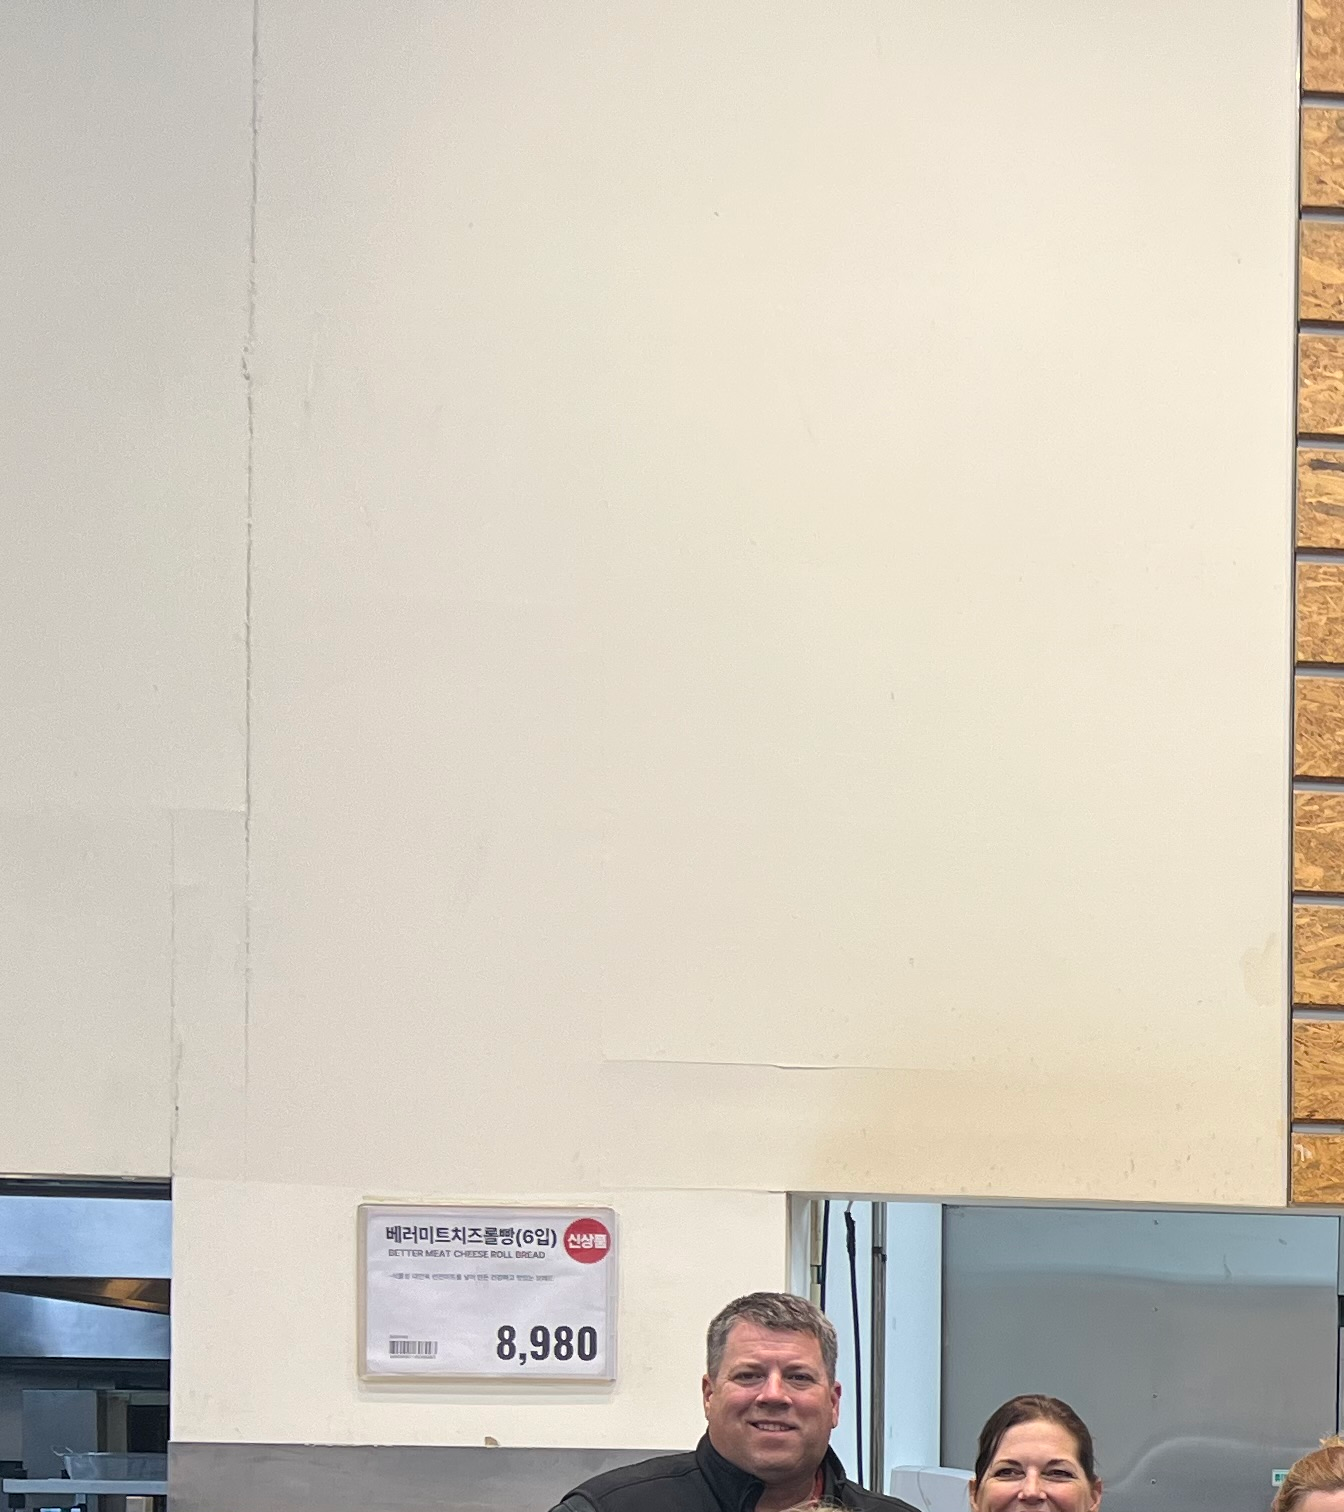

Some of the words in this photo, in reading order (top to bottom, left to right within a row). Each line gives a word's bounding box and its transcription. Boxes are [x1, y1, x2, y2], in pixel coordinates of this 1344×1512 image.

[386, 1226, 557, 1248] 베러미트치즈롤빵(6입)
[567, 1233, 607, 1249] 신상품
[388, 1249, 423, 1257] BETTER
[426, 1249, 451, 1257] MEAT
[454, 1250, 489, 1258] CHEESE
[491, 1250, 513, 1258] ROLL
[515, 1251, 545, 1259] BREAD
[496, 1325, 598, 1365] 8,980
